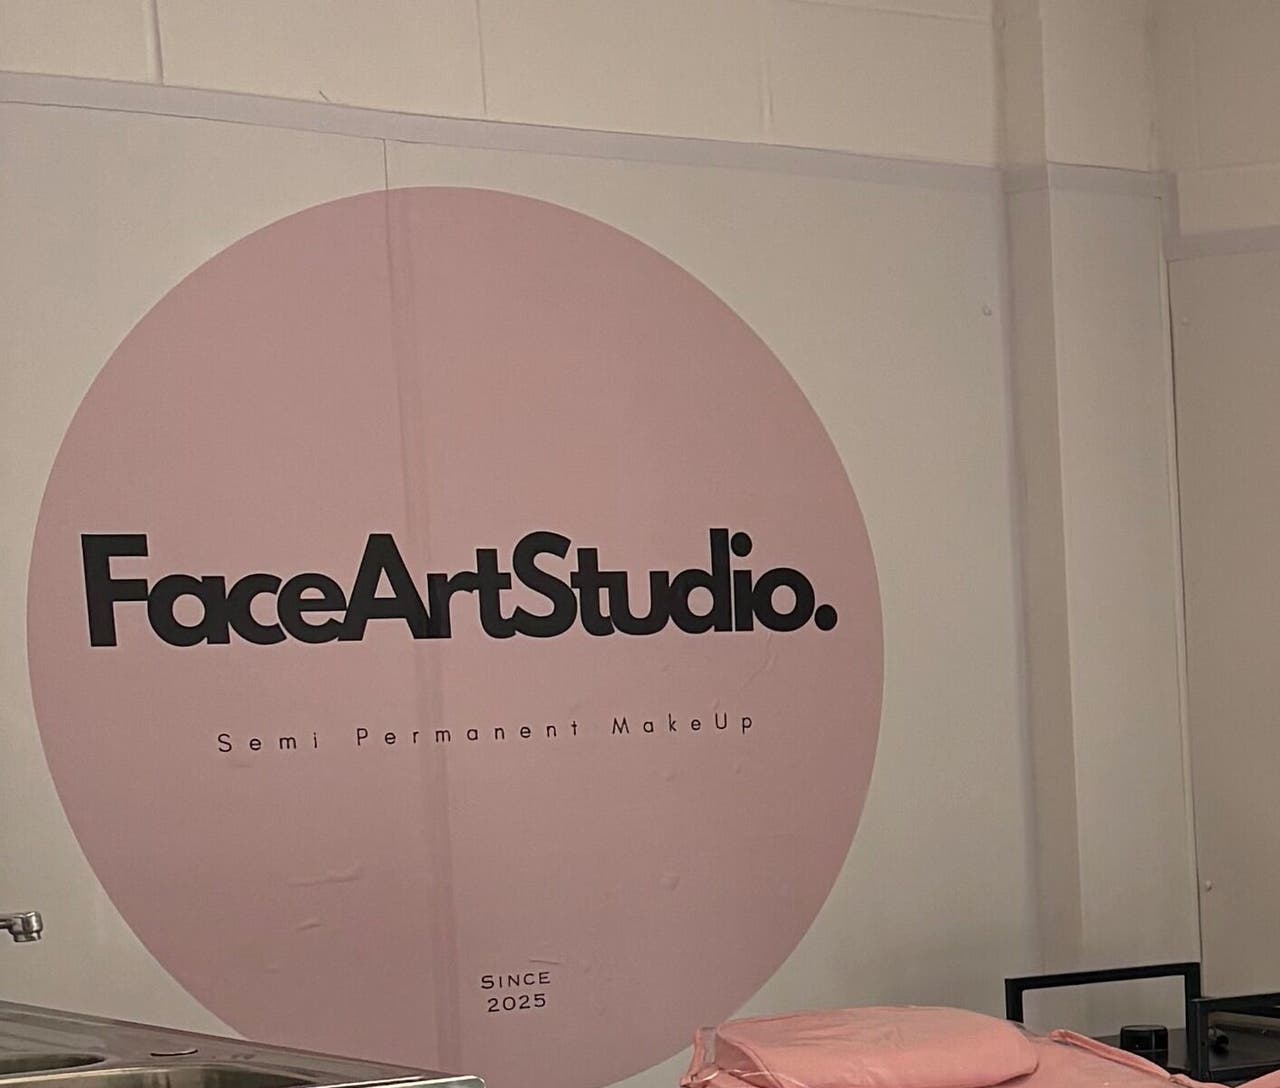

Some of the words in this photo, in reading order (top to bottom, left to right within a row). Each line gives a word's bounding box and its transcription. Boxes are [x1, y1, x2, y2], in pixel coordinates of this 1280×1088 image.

[80, 527, 838, 648] FaceArtStudio.
[217, 731, 319, 753] Semi
[356, 719, 579, 747] Permanent
[611, 711, 753, 736] MakeUp
[480, 971, 551, 990] SINCE
[487, 993, 546, 1013] 2025
